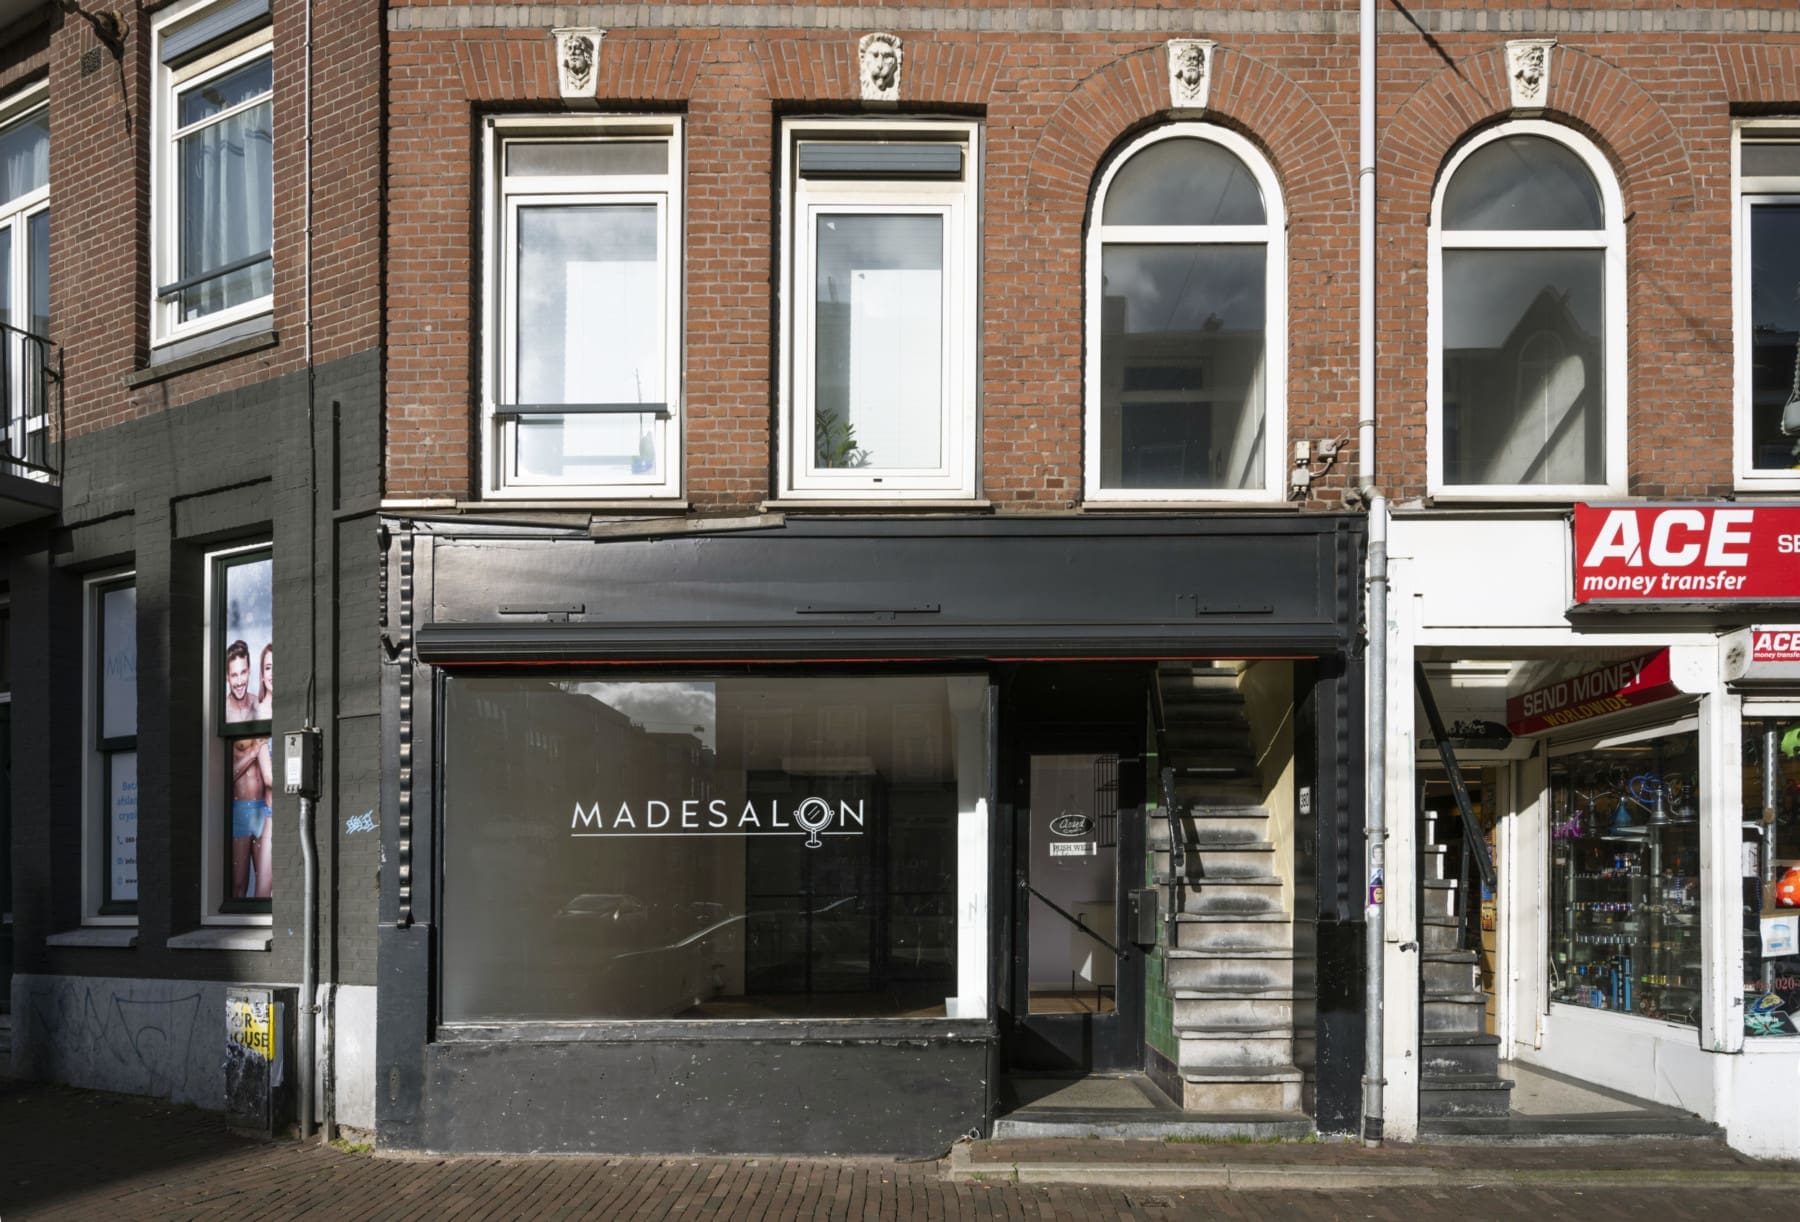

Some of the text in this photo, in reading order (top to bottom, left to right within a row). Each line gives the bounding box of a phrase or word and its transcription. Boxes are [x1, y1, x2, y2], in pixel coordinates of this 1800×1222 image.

[1583, 509, 1754, 567] ACE
[1583, 570, 1746, 595] money transfer
[1754, 633, 1800, 651] ACE
[1523, 658, 1644, 717] SEND MONEY
[1542, 694, 1633, 727] WORLDWIDE
[571, 797, 864, 831] MADESALON
